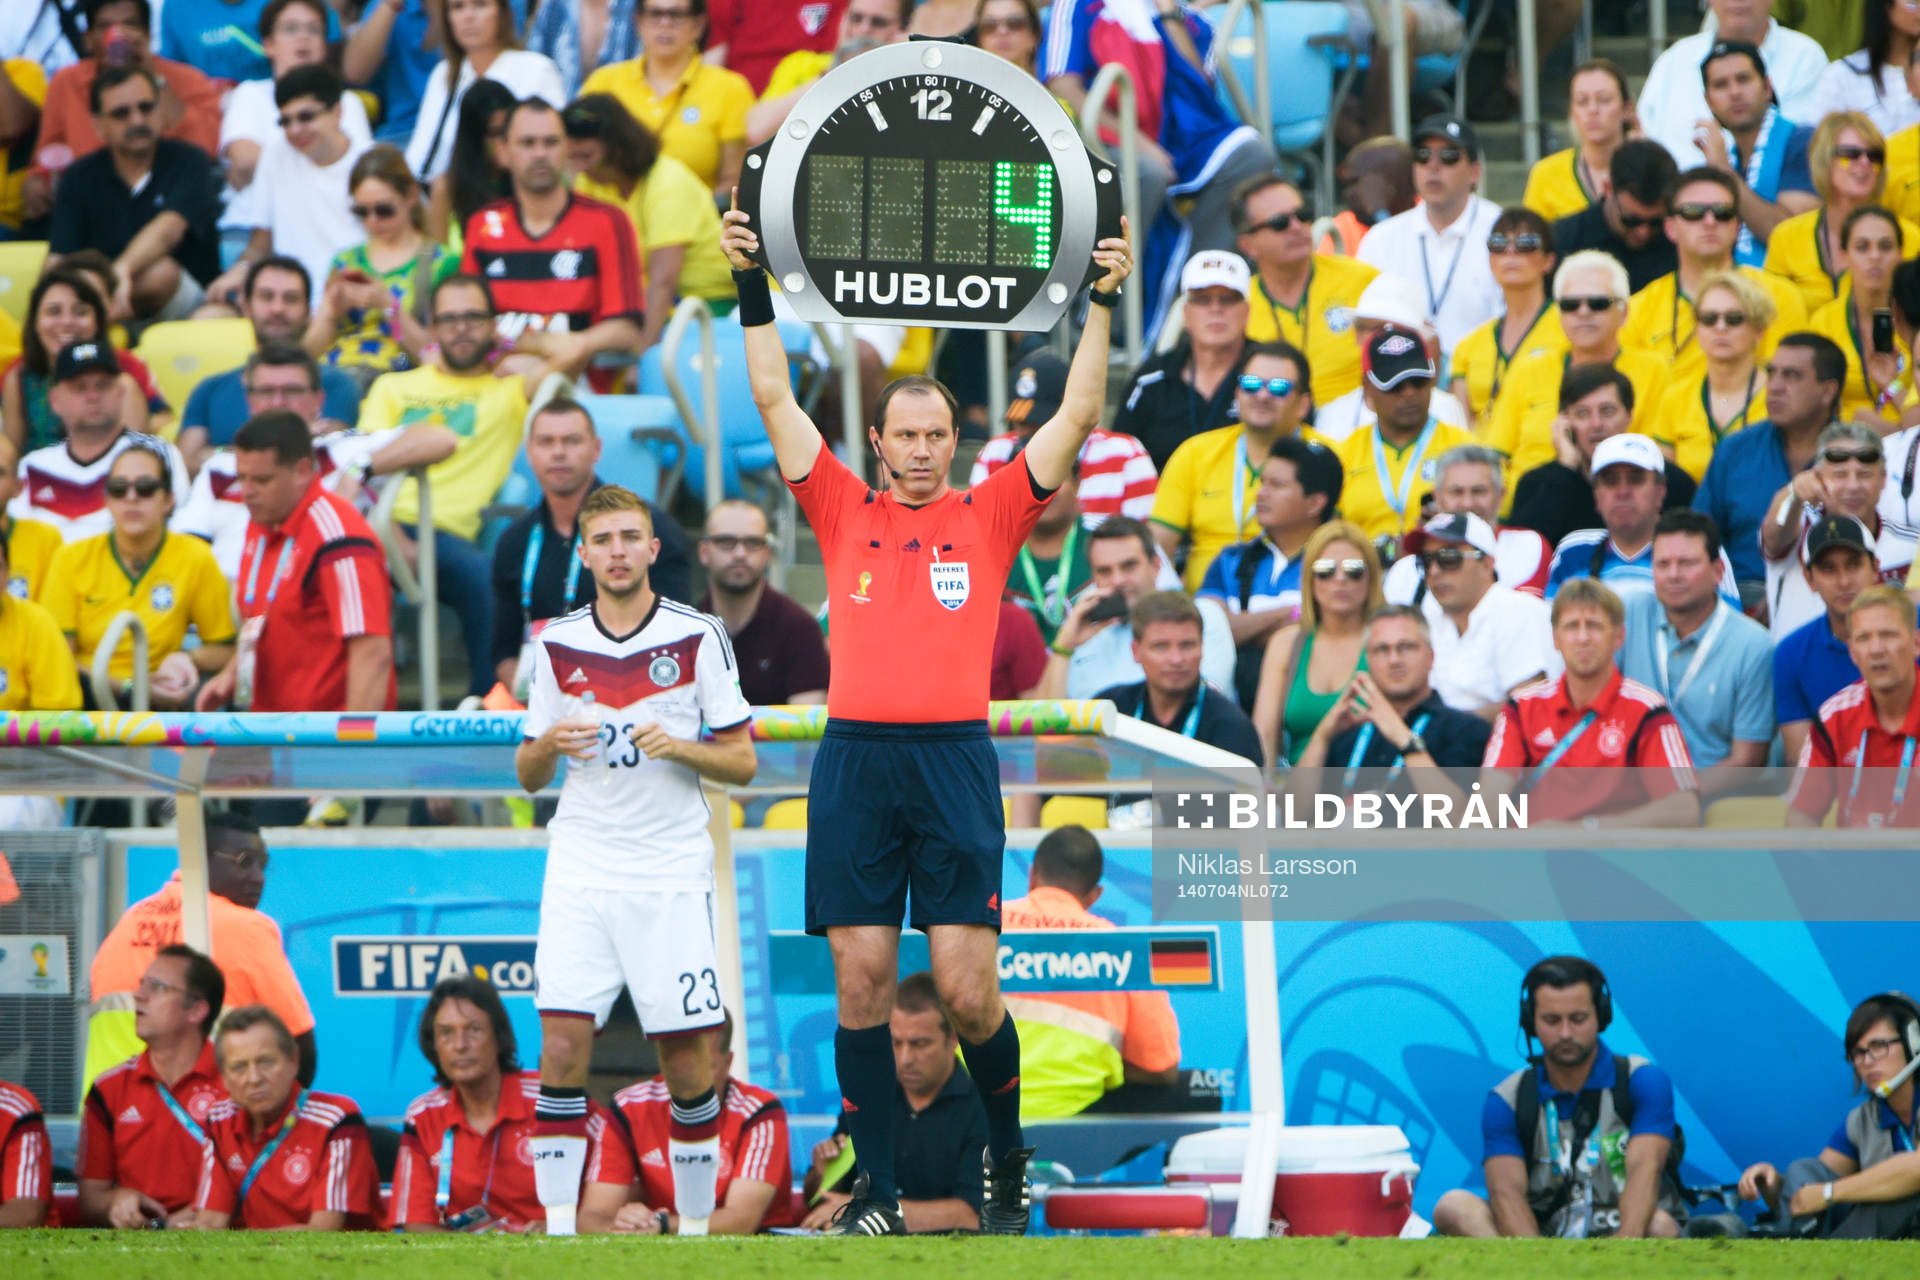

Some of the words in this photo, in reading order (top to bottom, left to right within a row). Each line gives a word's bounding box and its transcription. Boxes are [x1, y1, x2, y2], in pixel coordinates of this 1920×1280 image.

[924, 76, 938, 86] 60
[859, 90, 874, 103] 55
[910, 88, 953, 121] 12
[988, 94, 1003, 108] 05
[995, 162, 1052, 269] 4
[834, 270, 1017, 309] HUBLOT
[937, 581, 965, 591] FIFA
[410, 714, 523, 742] Germany
[995, 945, 1133, 987] Germany
[678, 967, 721, 1017] 23
[1189, 1069, 1235, 1089] AGC
[674, 1154, 713, 1165] DFB
